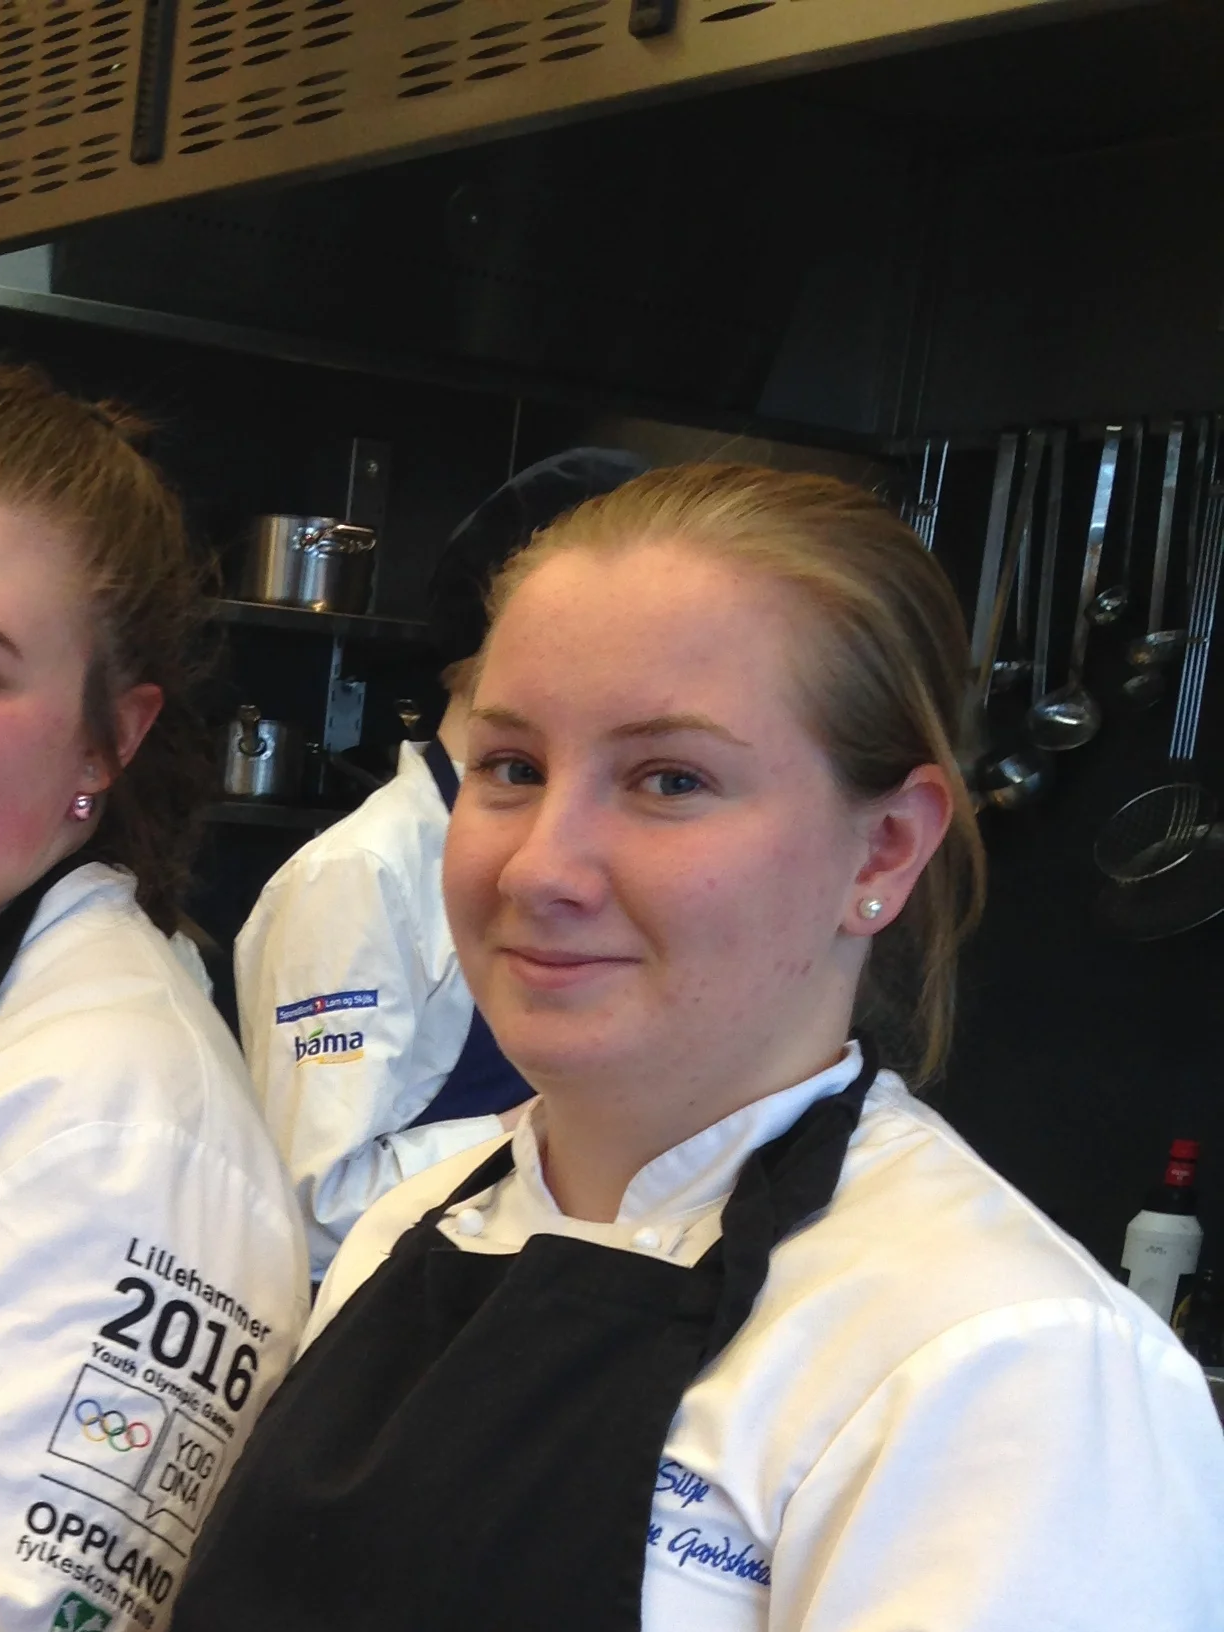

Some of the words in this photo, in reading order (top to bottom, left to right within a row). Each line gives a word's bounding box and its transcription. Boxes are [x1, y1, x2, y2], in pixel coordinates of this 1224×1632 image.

[125, 1236, 272, 1344] Lillehammer
[91, 1341, 137, 1378] Youth
[142, 1368, 200, 1412] Olympic
[98, 1276, 258, 1412] 2016
[159, 1463, 201, 1511] DNA
[176, 1432, 216, 1479] YOG
[26, 1501, 173, 1605] OPPLAND
